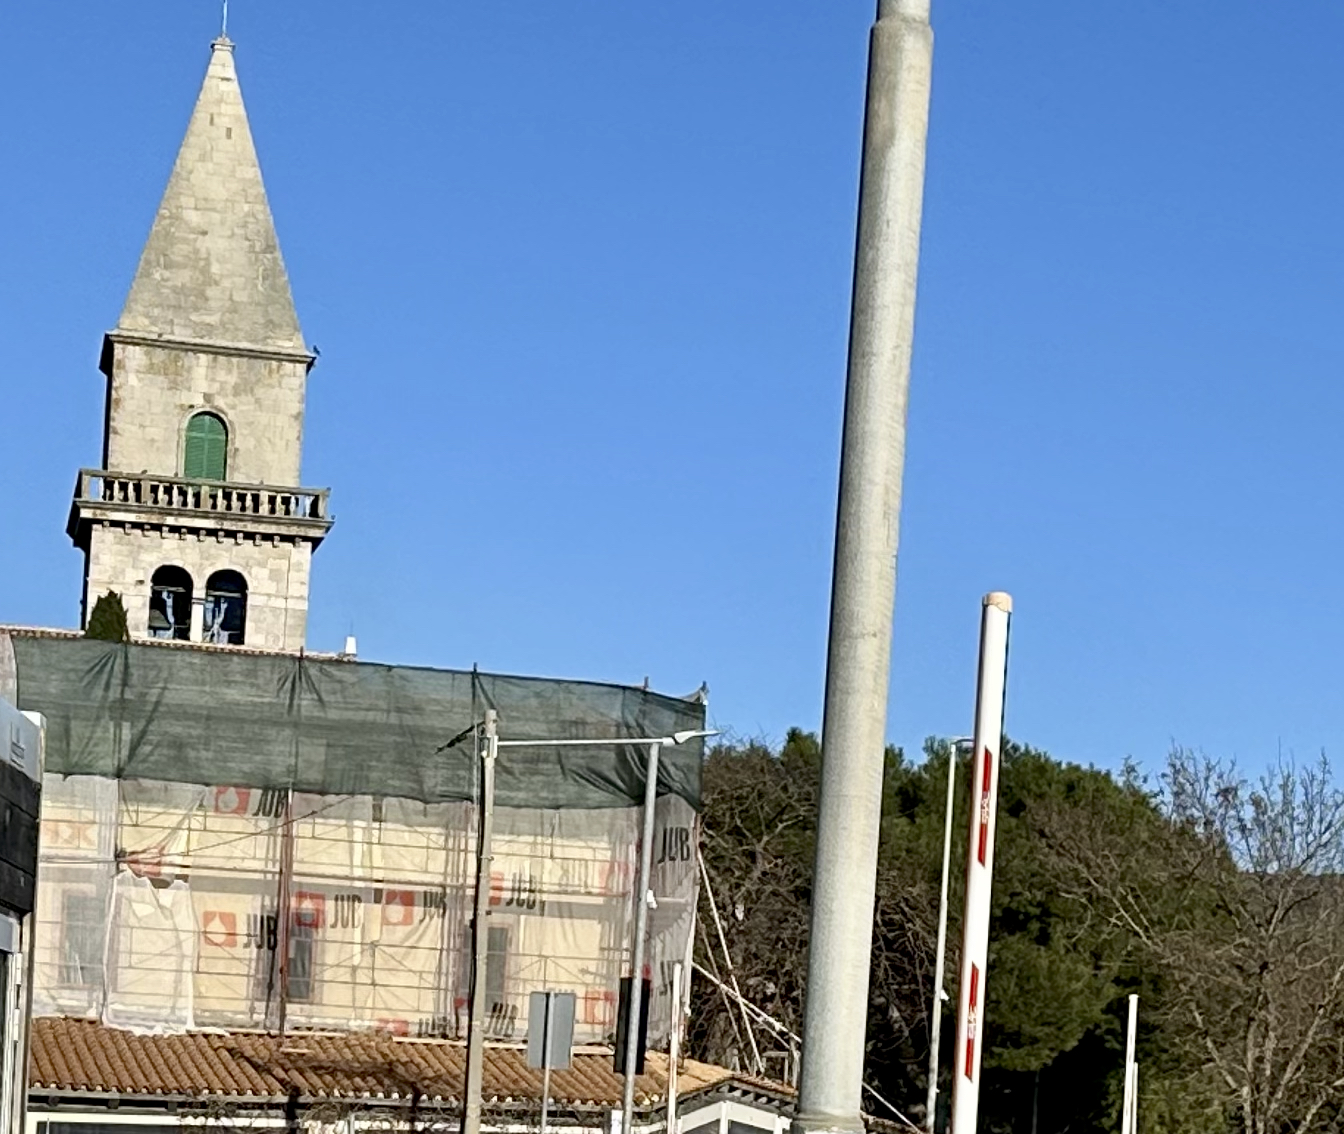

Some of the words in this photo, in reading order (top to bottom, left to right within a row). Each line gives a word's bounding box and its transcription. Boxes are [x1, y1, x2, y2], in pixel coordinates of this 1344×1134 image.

[252, 787, 288, 819] JUB
[658, 827, 690, 863] JUB
[330, 894, 363, 929] JUB
[243, 914, 278, 950] JUB
